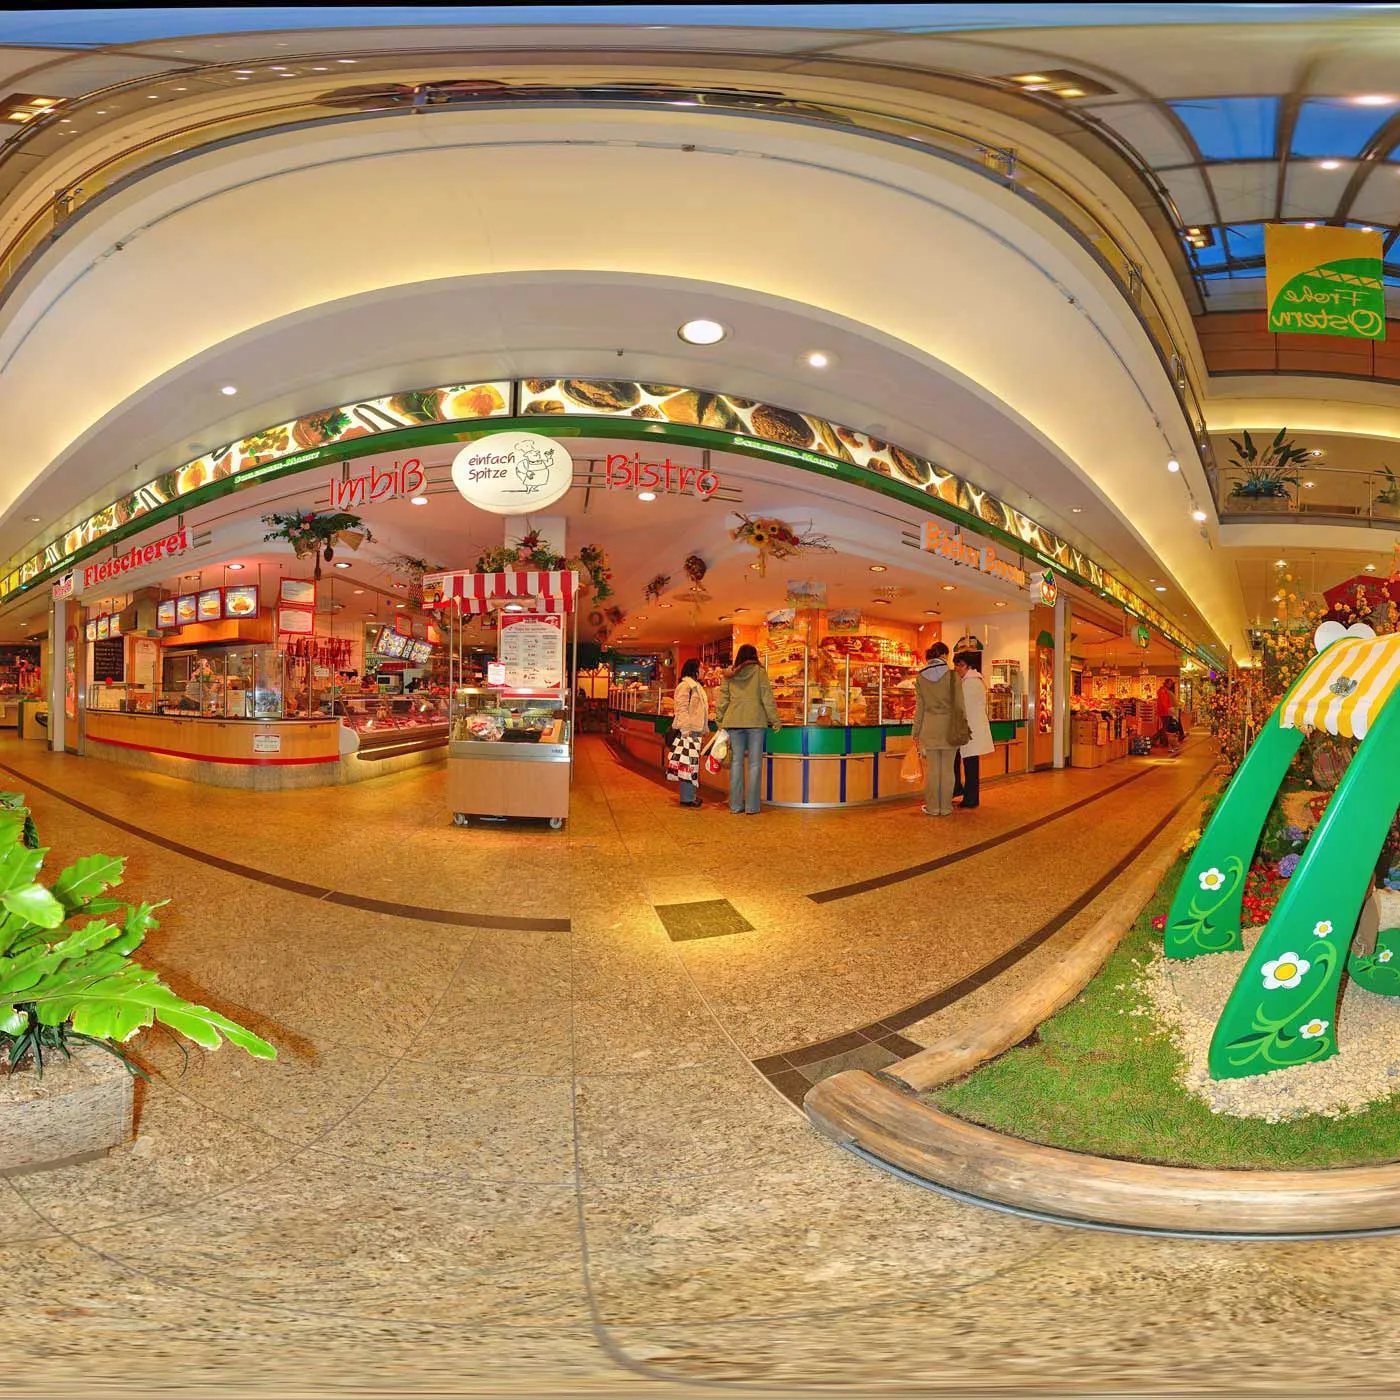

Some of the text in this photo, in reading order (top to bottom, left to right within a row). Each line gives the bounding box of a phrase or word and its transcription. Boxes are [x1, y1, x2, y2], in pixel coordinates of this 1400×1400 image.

[468, 452, 515, 466] einfach
[468, 467, 508, 483] Spitze
[605, 452, 720, 494] Bistro
[329, 458, 424, 506] Imbiß
[83, 525, 188, 589] Fleischerei
